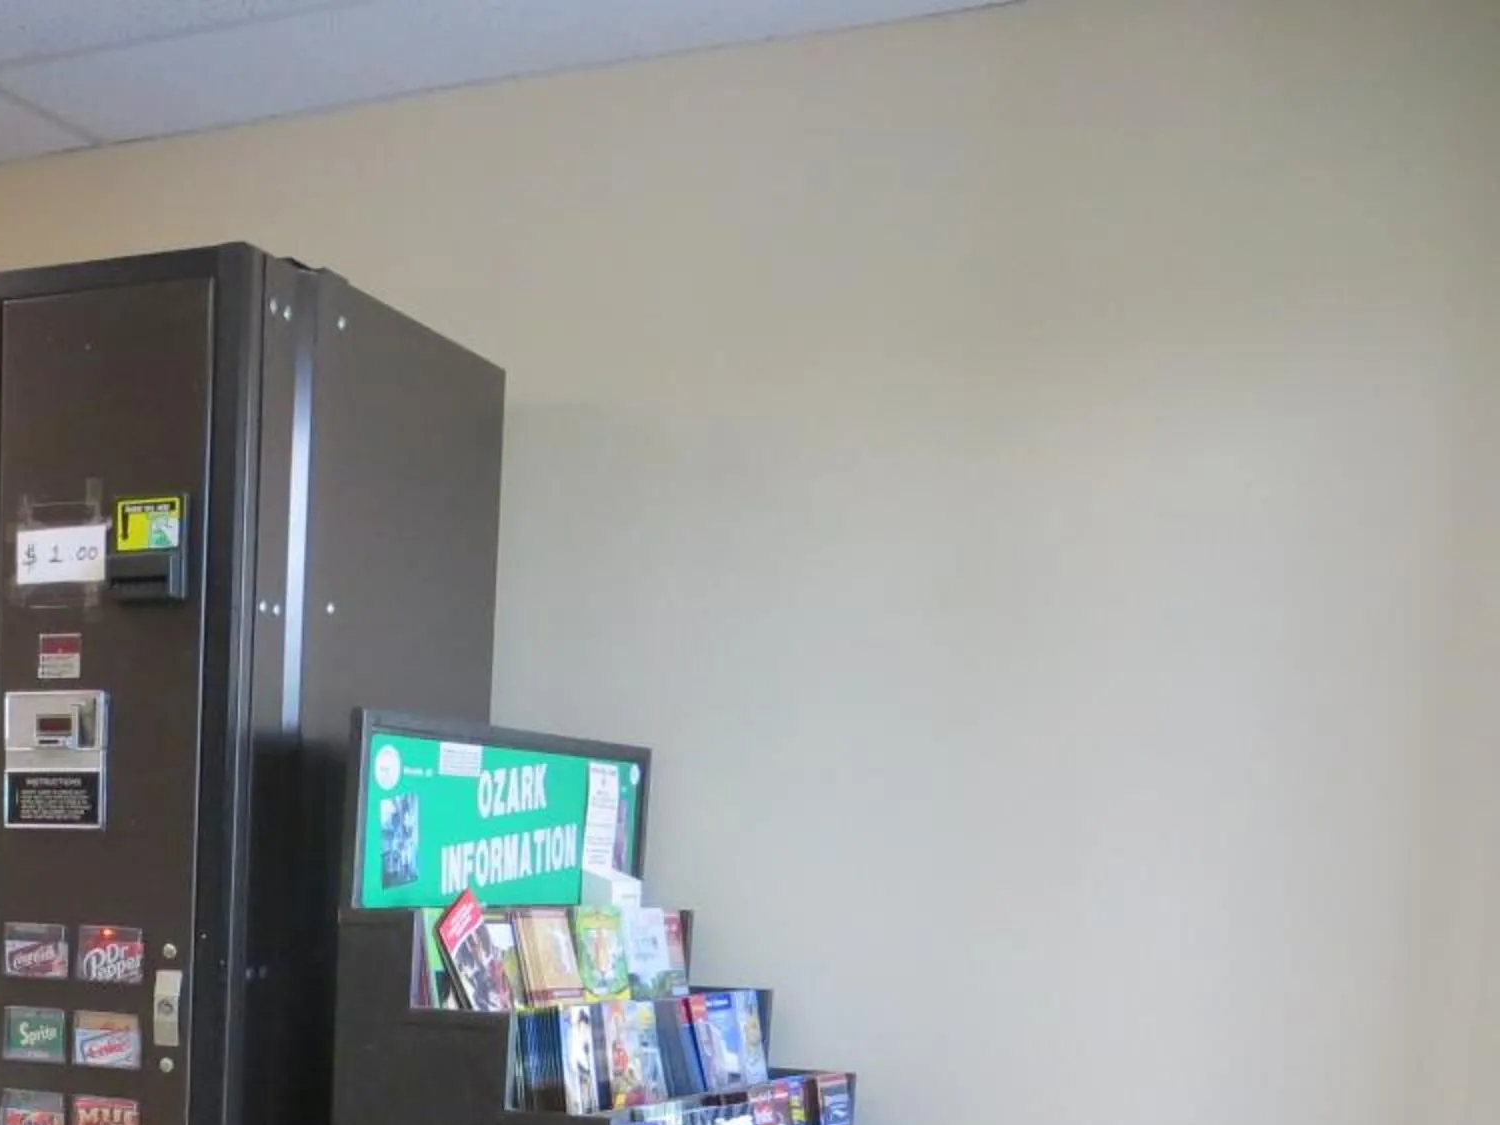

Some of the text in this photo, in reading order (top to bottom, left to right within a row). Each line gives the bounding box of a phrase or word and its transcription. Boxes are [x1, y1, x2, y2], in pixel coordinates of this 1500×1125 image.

[478, 762, 548, 818] OZARK
[440, 822, 578, 896] INFORMATION
[83, 947, 143, 982] Pepper
[105, 942, 130, 962] Dr
[19, 1020, 58, 1047] Sprite
